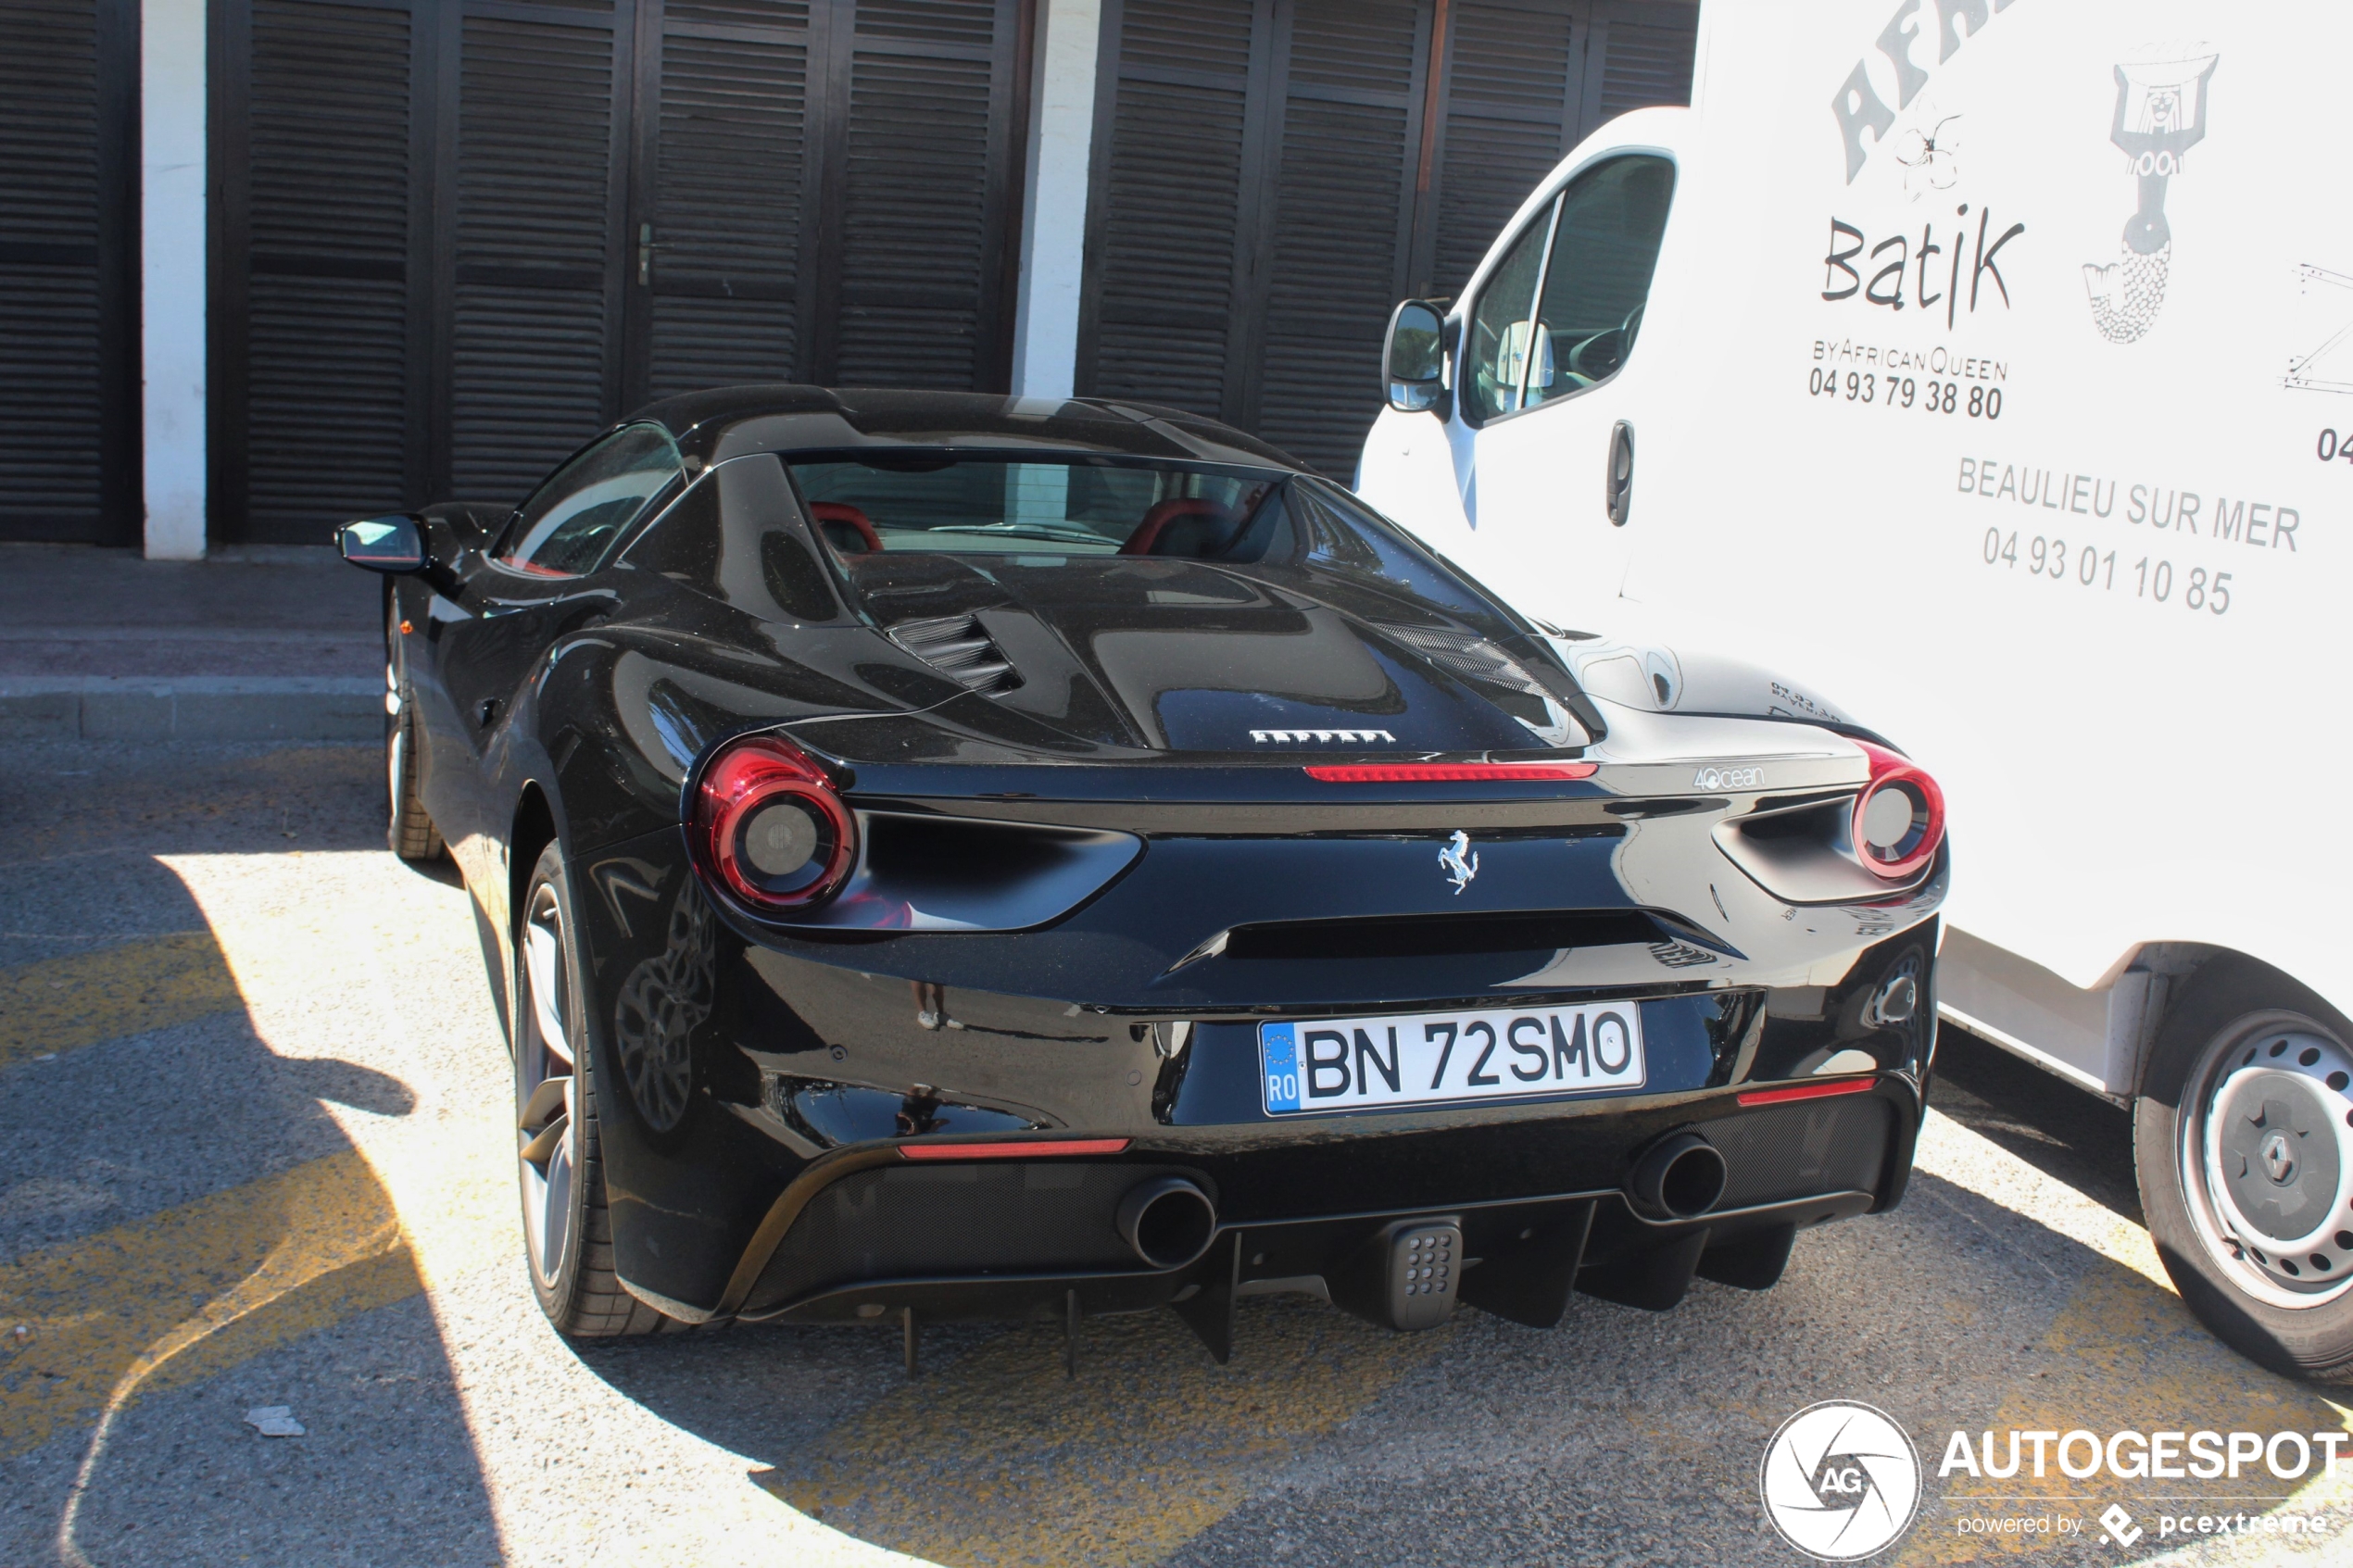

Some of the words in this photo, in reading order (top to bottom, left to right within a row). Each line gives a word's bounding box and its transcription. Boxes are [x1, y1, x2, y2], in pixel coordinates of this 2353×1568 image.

[1821, 204, 2024, 331] Batik
[1809, 368, 1837, 397] 04
[1846, 371, 1875, 404] 93
[1886, 376, 1915, 408] 79
[1925, 381, 1957, 415] 38
[1968, 385, 2003, 420] 80
[1957, 458, 2116, 518] BEAULIEU
[2126, 483, 2201, 534] SUR
[2213, 497, 2300, 552] MER
[1983, 526, 2018, 569] 04
[2030, 535, 2067, 580] 93
[2079, 545, 2117, 590] 01
[2133, 556, 2172, 602] 10
[2186, 567, 2233, 615] 85
[1268, 1073, 1297, 1101] RO
[1304, 1026, 1402, 1099] BN
